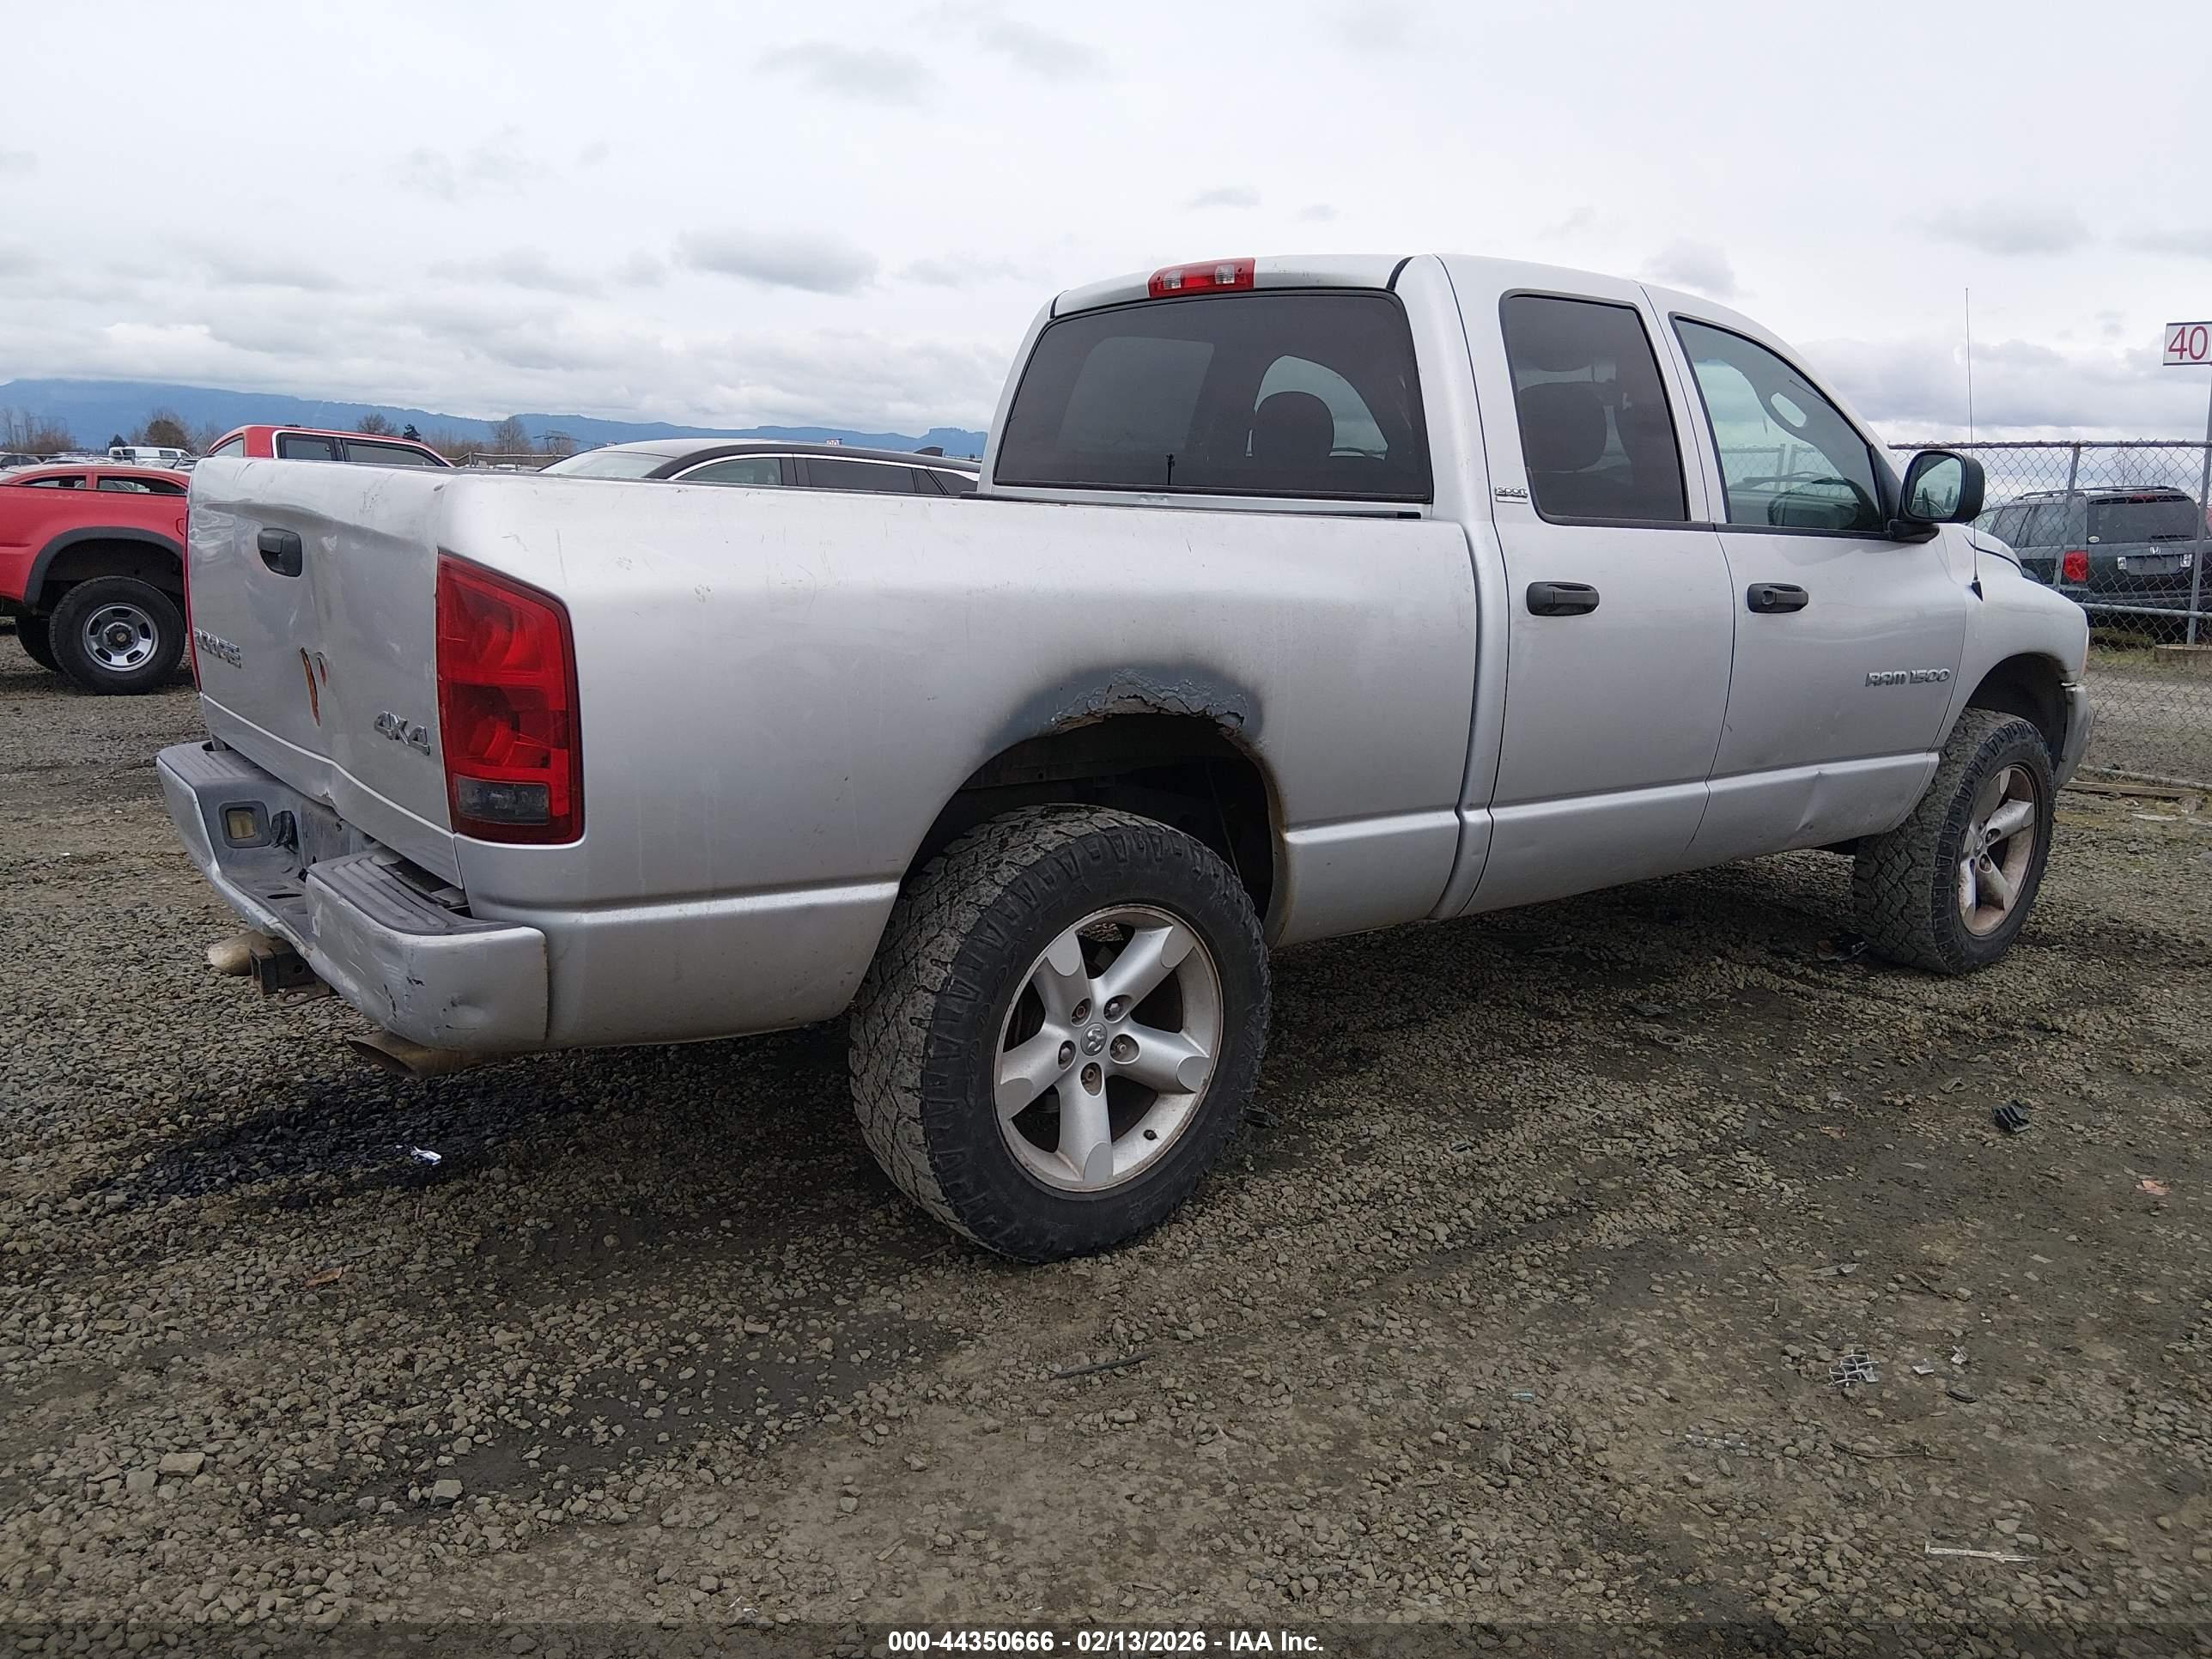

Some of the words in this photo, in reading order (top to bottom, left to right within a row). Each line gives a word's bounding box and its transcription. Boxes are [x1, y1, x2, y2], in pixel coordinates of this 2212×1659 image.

[2168, 325, 2209, 361] 40
[1864, 671, 1906, 687] RAM
[1909, 668, 1951, 684] 1500
